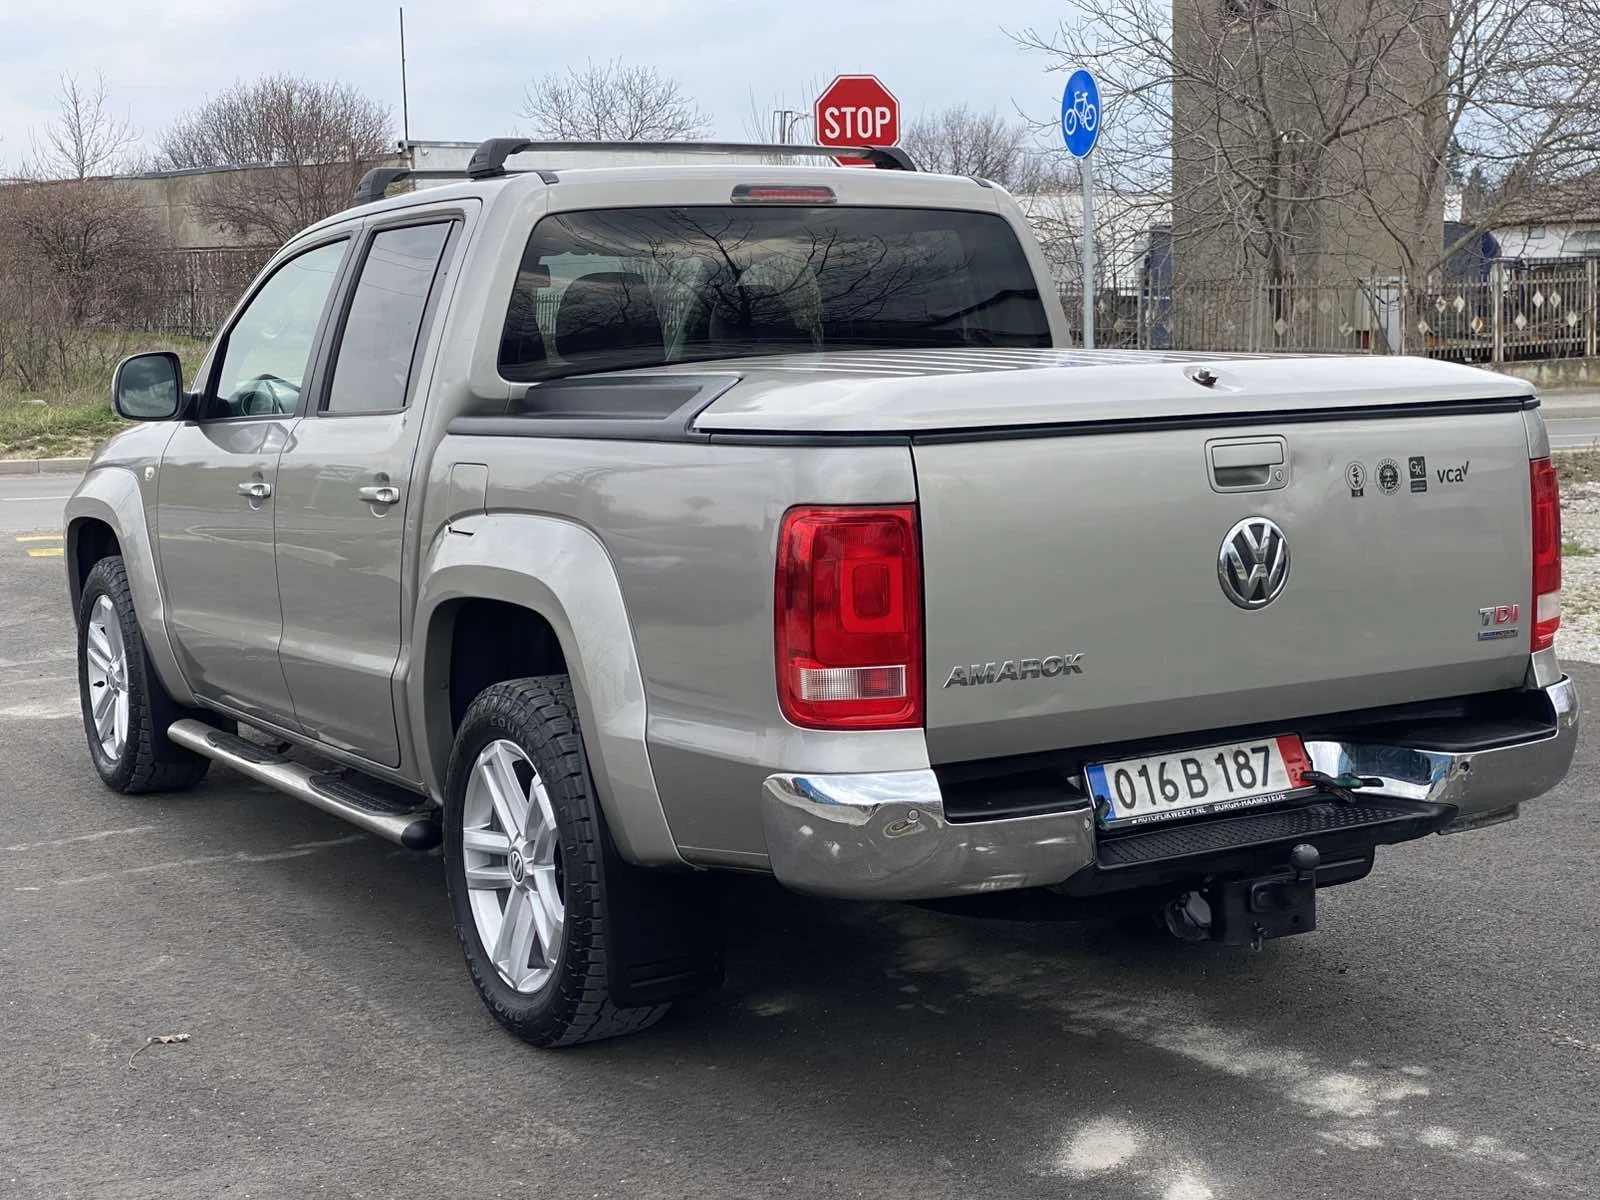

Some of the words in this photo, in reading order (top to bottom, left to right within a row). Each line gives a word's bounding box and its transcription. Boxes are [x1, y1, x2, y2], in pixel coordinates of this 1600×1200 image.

[824, 106, 891, 139] STOP
[1478, 604, 1519, 626] TDI
[942, 652, 1086, 689] AMAROK
